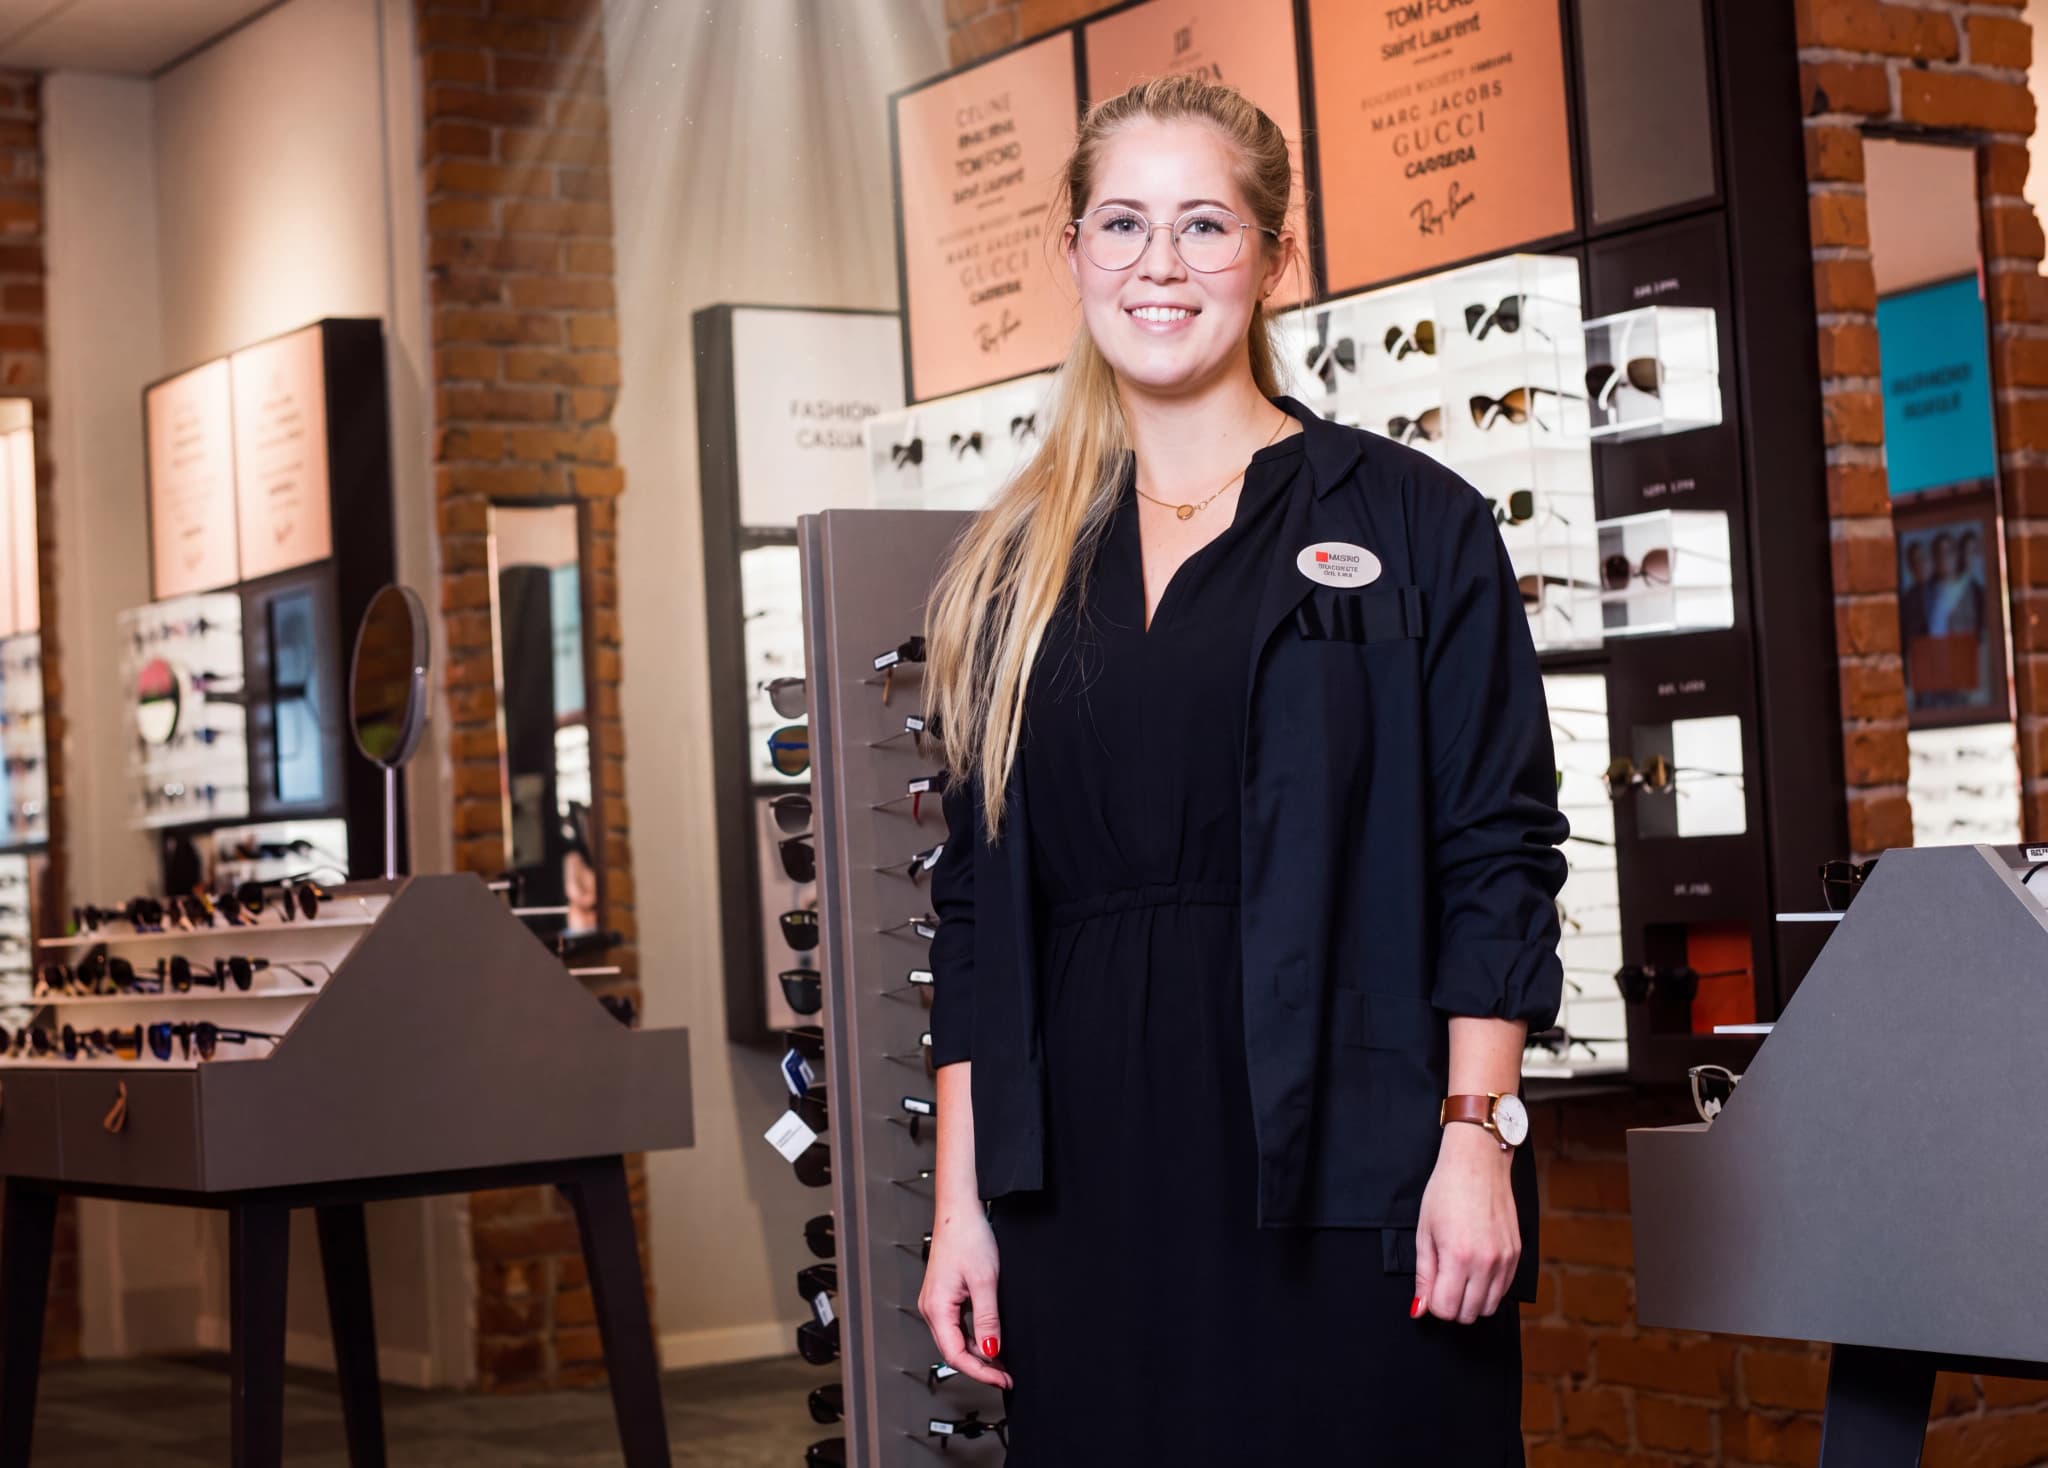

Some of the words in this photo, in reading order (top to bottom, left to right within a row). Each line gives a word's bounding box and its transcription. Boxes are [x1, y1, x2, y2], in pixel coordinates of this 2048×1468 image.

[1385, 1, 1423, 30] TOM
[1420, 11, 1480, 49] Laurent
[1371, 104, 1421, 132] MARC
[1430, 79, 1503, 117] JACOBS
[1392, 109, 1485, 158] GUCCI
[1405, 144, 1476, 179] CARRERA
[1409, 180, 1475, 237] Ray-Ban
